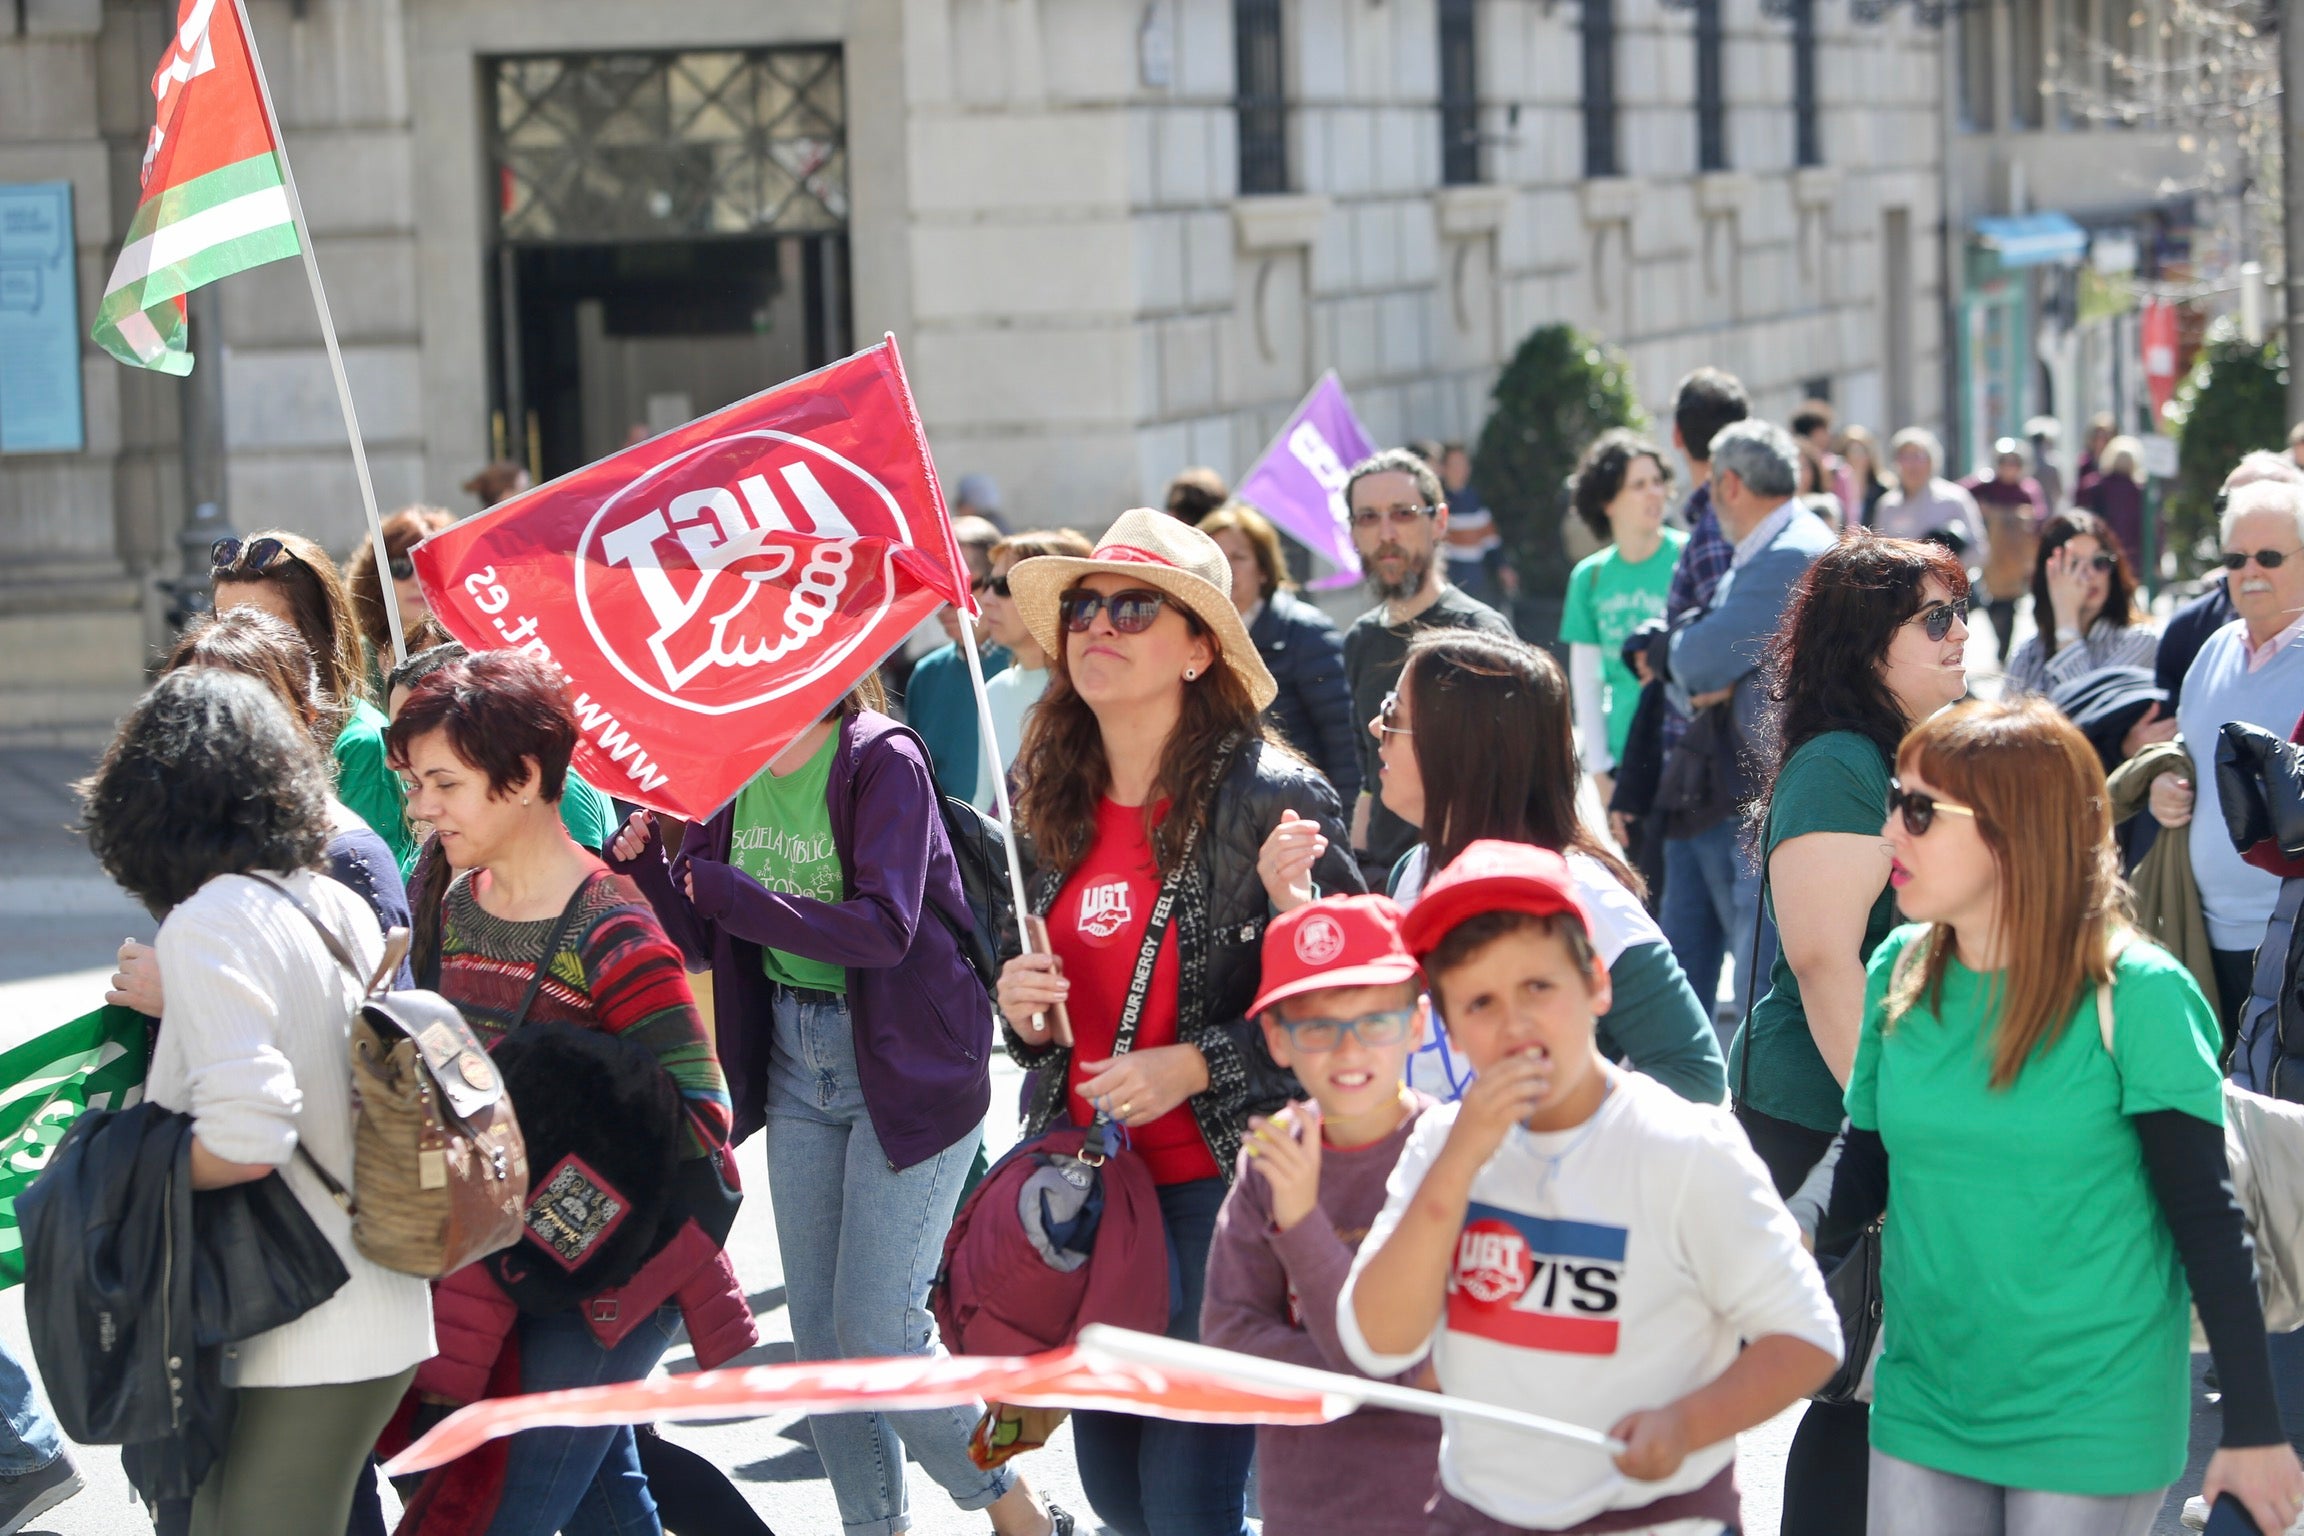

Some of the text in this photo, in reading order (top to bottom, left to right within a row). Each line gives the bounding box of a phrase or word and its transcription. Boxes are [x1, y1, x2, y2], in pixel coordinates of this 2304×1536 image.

[731, 826, 785, 856] SCUELA
[1080, 881, 1130, 918] UGT
[1119, 994, 1142, 1032] YOUR
[1131, 935, 1160, 994] ENERGY
[1151, 894, 1176, 928] FEEL
[1458, 1231, 1525, 1277] UGT
